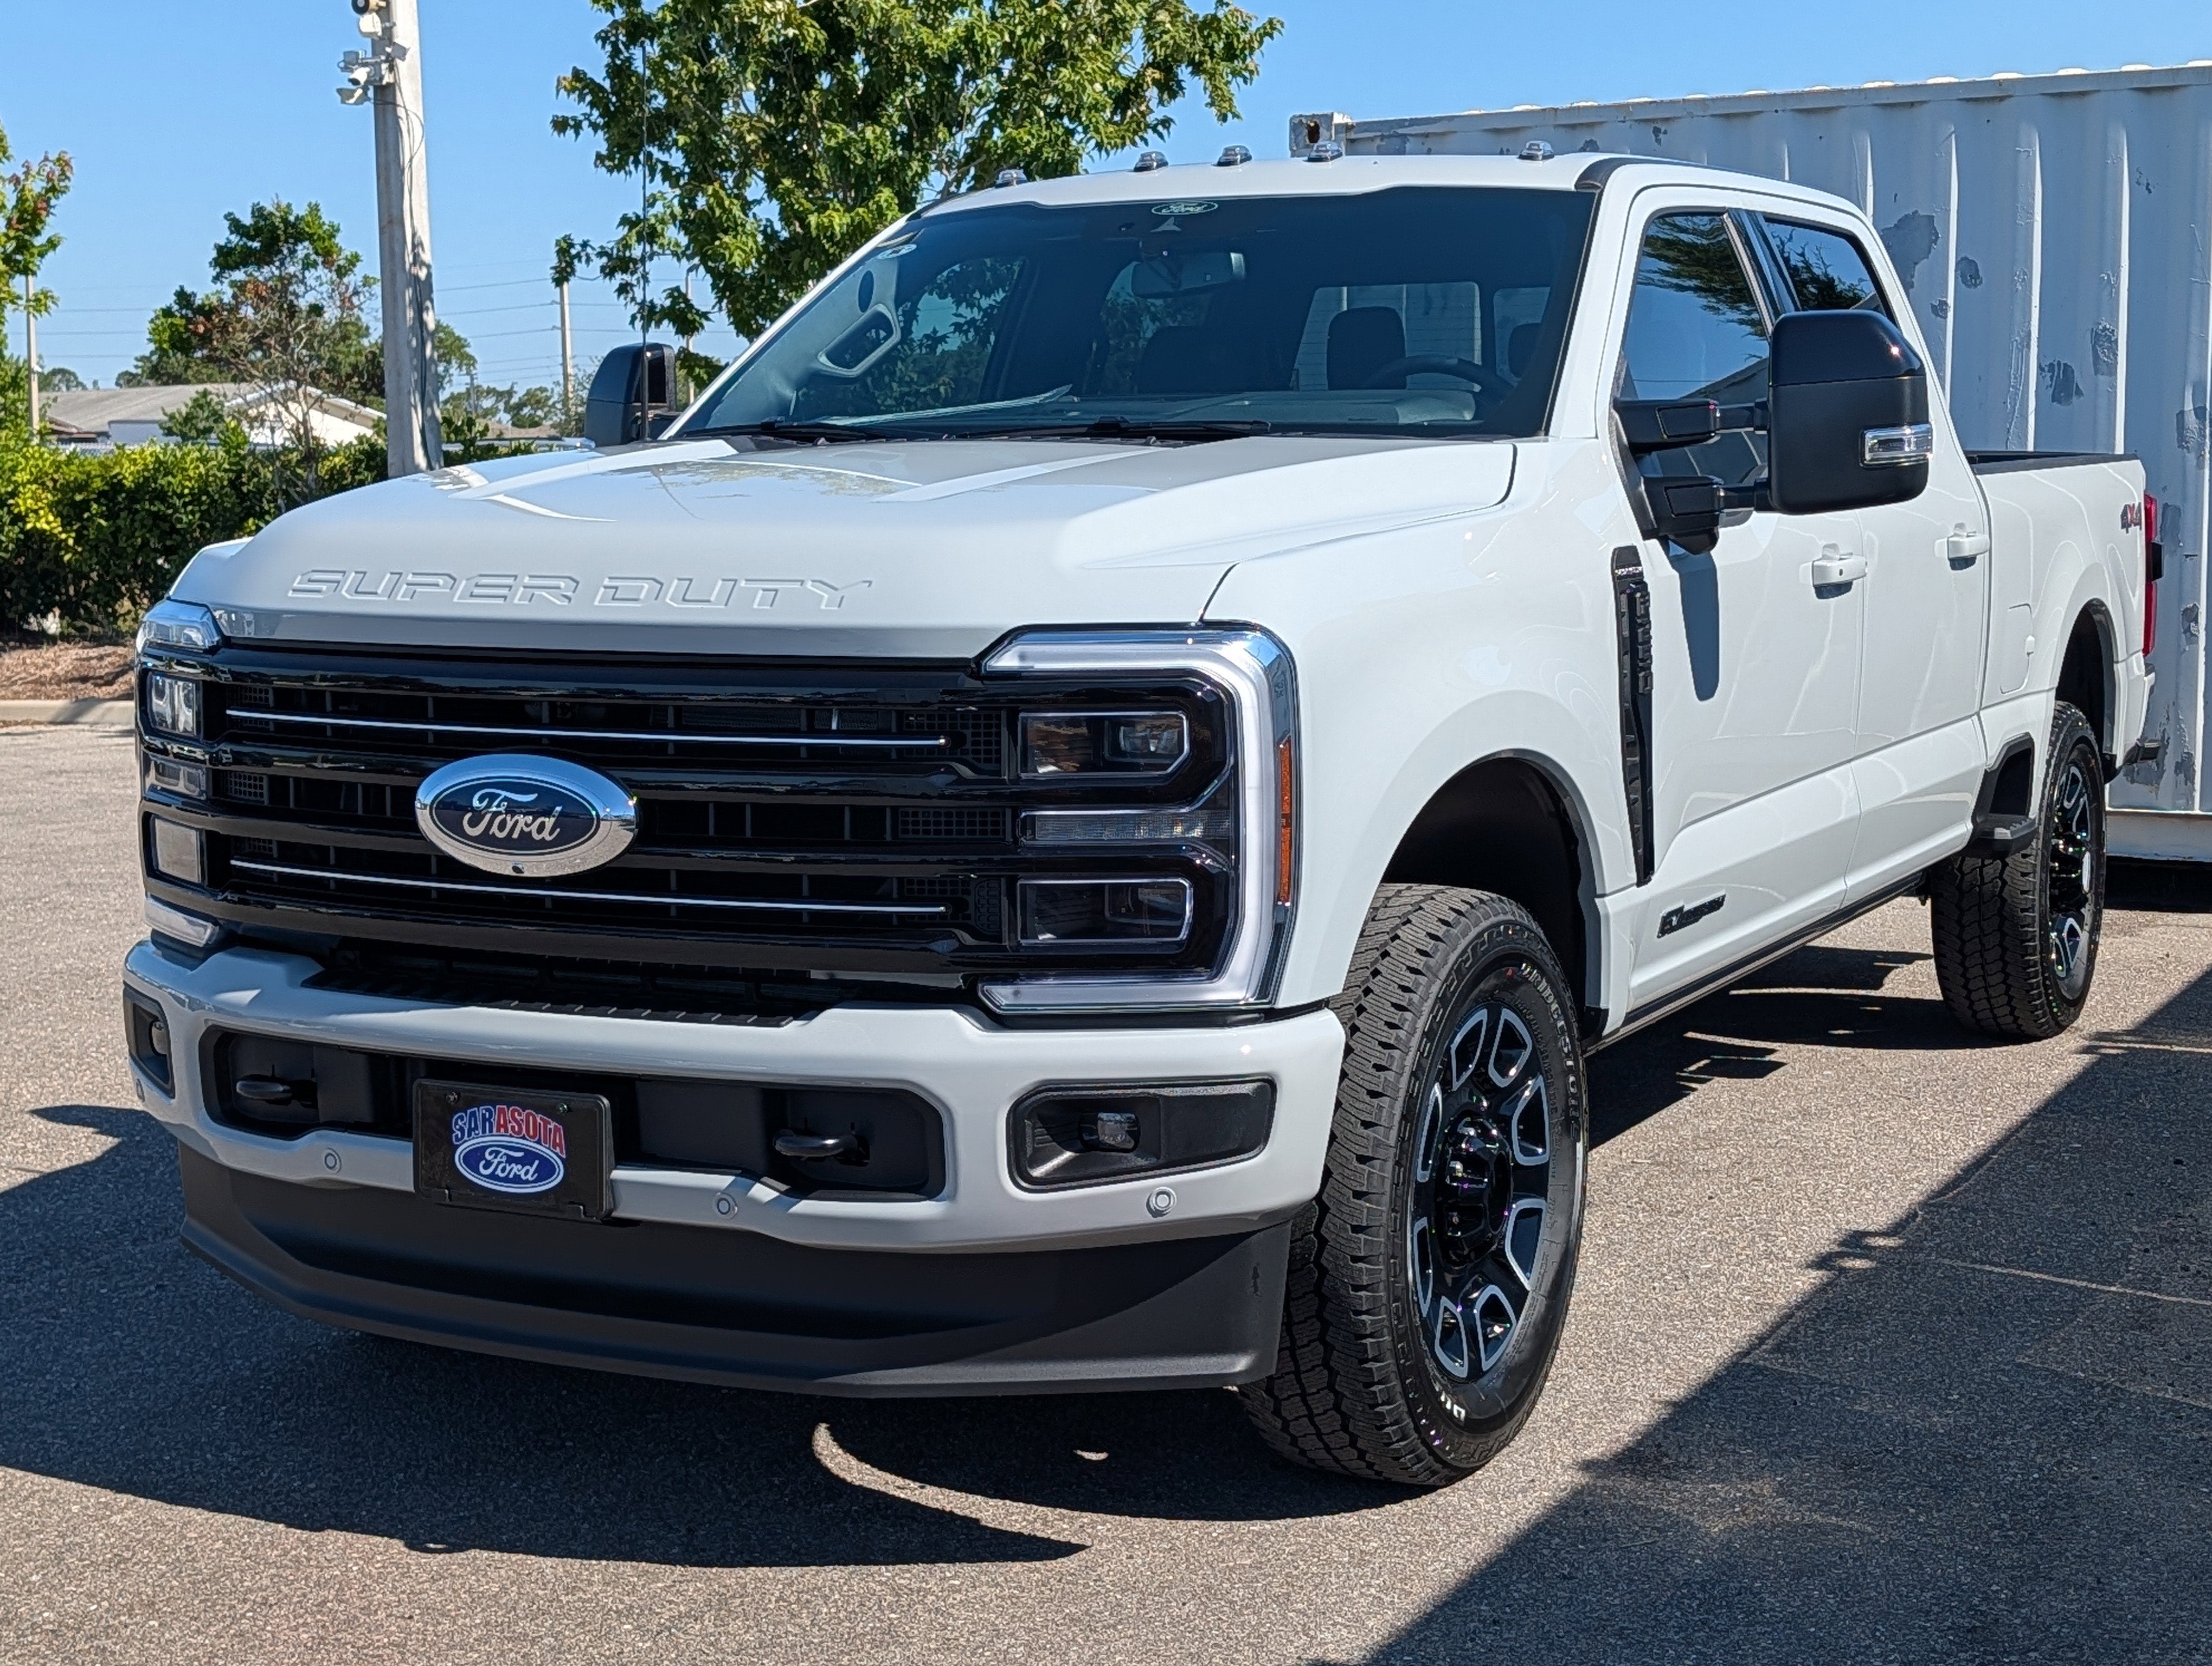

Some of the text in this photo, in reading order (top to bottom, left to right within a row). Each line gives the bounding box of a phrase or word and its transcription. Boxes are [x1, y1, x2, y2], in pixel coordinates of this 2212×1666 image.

[1161, 202, 1207, 213] Ford
[286, 568, 873, 610] SUPER DUTY
[462, 788, 563, 841] Ford
[452, 1105, 567, 1158] SARASOTA
[479, 1147, 539, 1181] Ford
